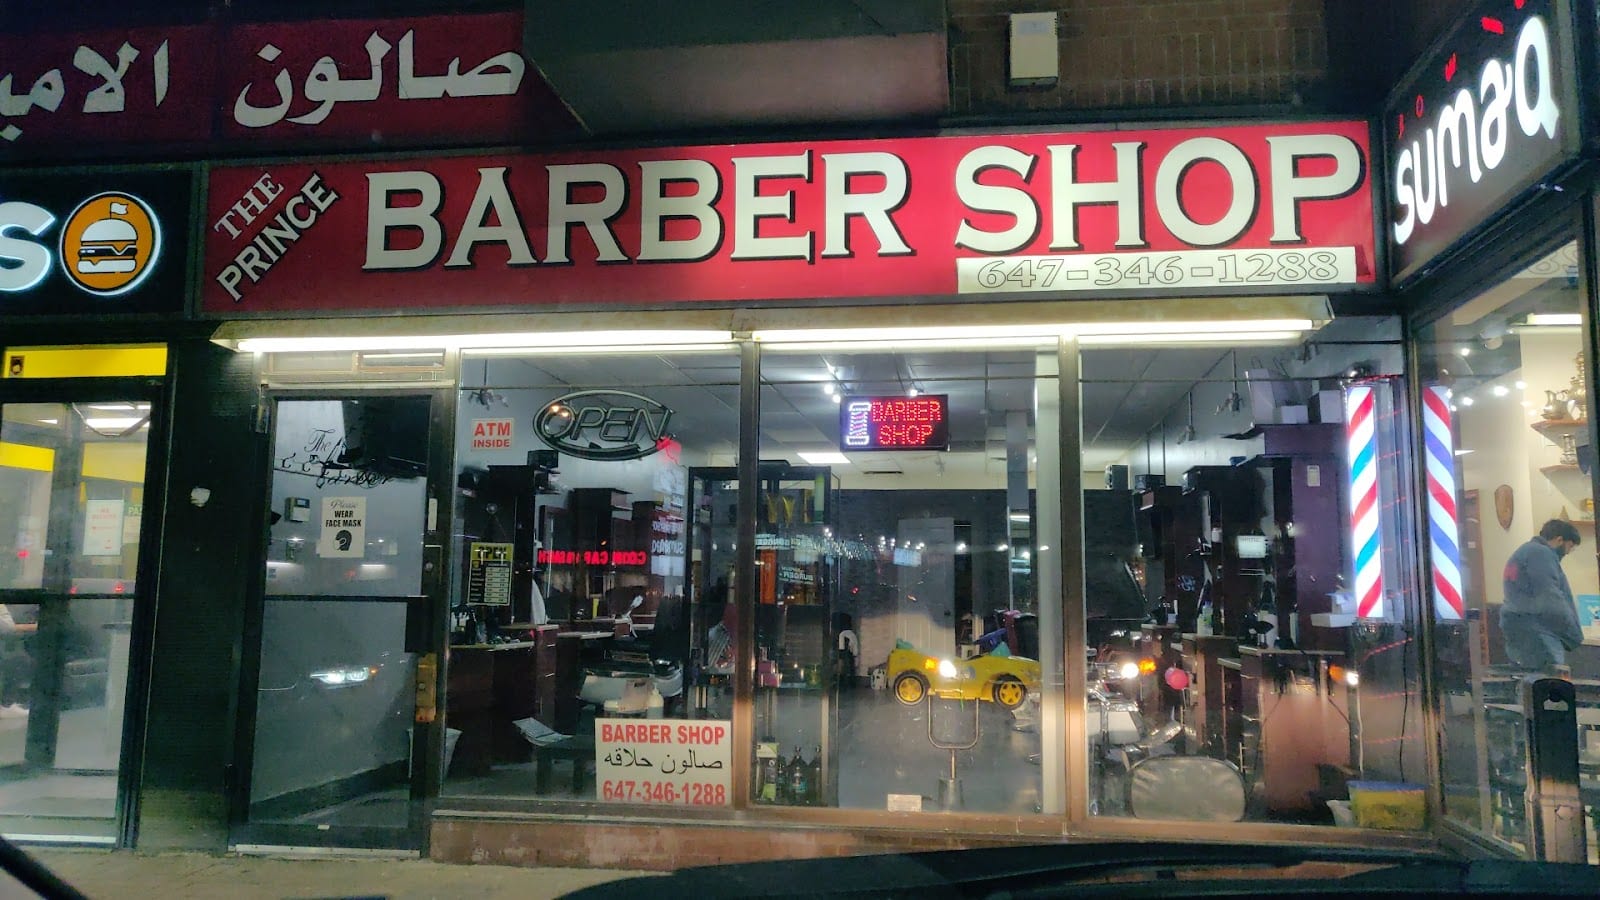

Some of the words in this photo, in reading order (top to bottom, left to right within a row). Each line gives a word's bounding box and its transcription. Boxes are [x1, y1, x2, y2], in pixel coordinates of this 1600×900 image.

[234, 29, 525, 127] صالون
[213, 172, 285, 241] THE
[361, 150, 917, 271] BARBER
[955, 134, 1366, 255] SHOP
[216, 173, 338, 302] PRINCE
[977, 251, 1340, 289] 647-346-1288
[541, 405, 673, 442] OPEN
[872, 401, 941, 421] BARBER
[474, 422, 511, 437] ATM
[880, 424, 933, 444] SHOP
[473, 439, 510, 448] INSIDE
[325, 519, 341, 528] FACE
[343, 519, 362, 528] MASK
[334, 510, 354, 518] WEAR
[601, 723, 672, 744] BARBER
[677, 725, 725, 746] SHOP
[661, 748, 723, 775] صالون
[603, 779, 726, 806] 647-346-1288
